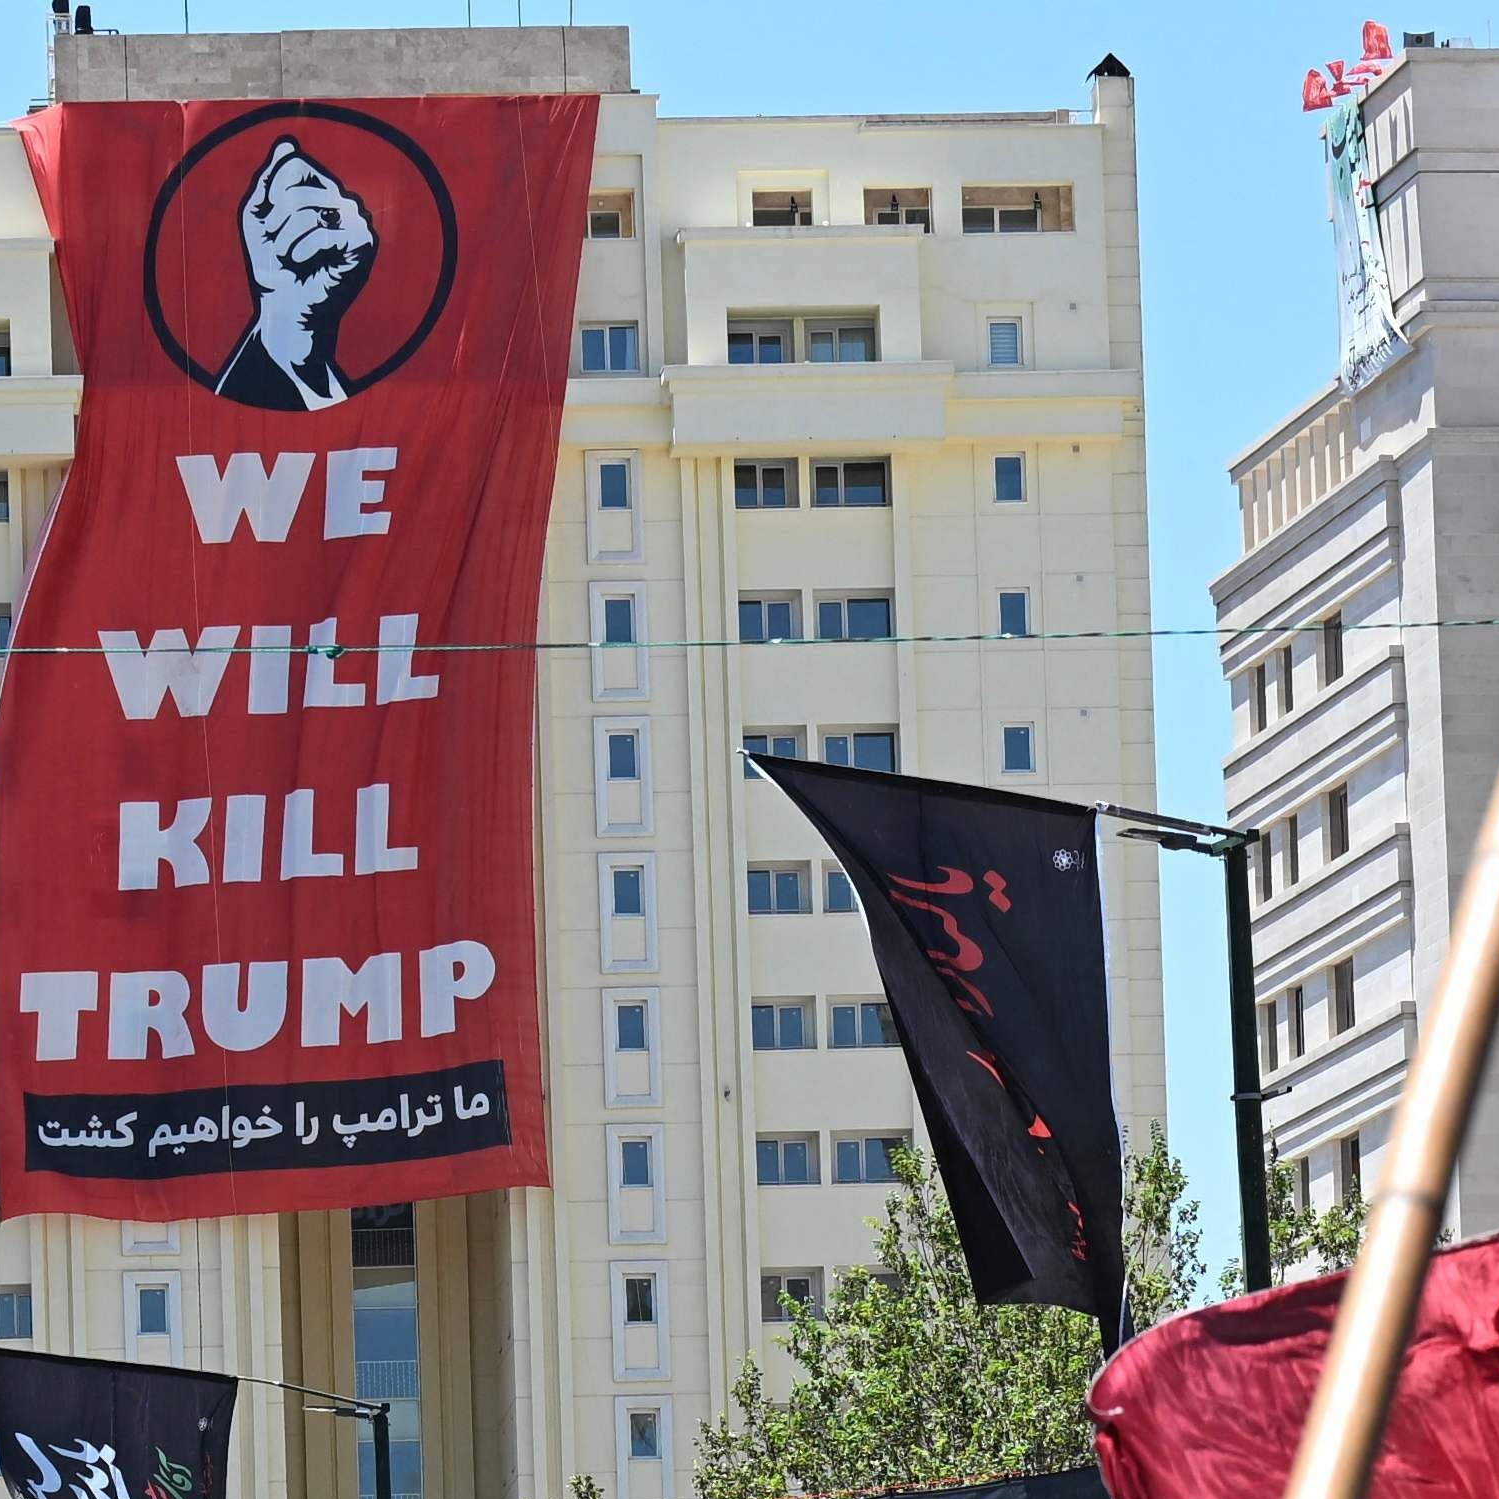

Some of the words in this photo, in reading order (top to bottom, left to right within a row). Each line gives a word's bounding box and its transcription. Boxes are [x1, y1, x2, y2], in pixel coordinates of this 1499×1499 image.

[174, 446, 399, 544] WE
[98, 612, 441, 720] WILL
[117, 782, 420, 892] KILL
[19, 940, 497, 1061] TRUMP
[38, 1111, 137, 1150] کشت
[147, 1105, 283, 1157] خواهیم
[296, 1101, 320, 1144] را
[332, 1092, 443, 1149] ترامپ
[453, 1085, 490, 1122] ما
